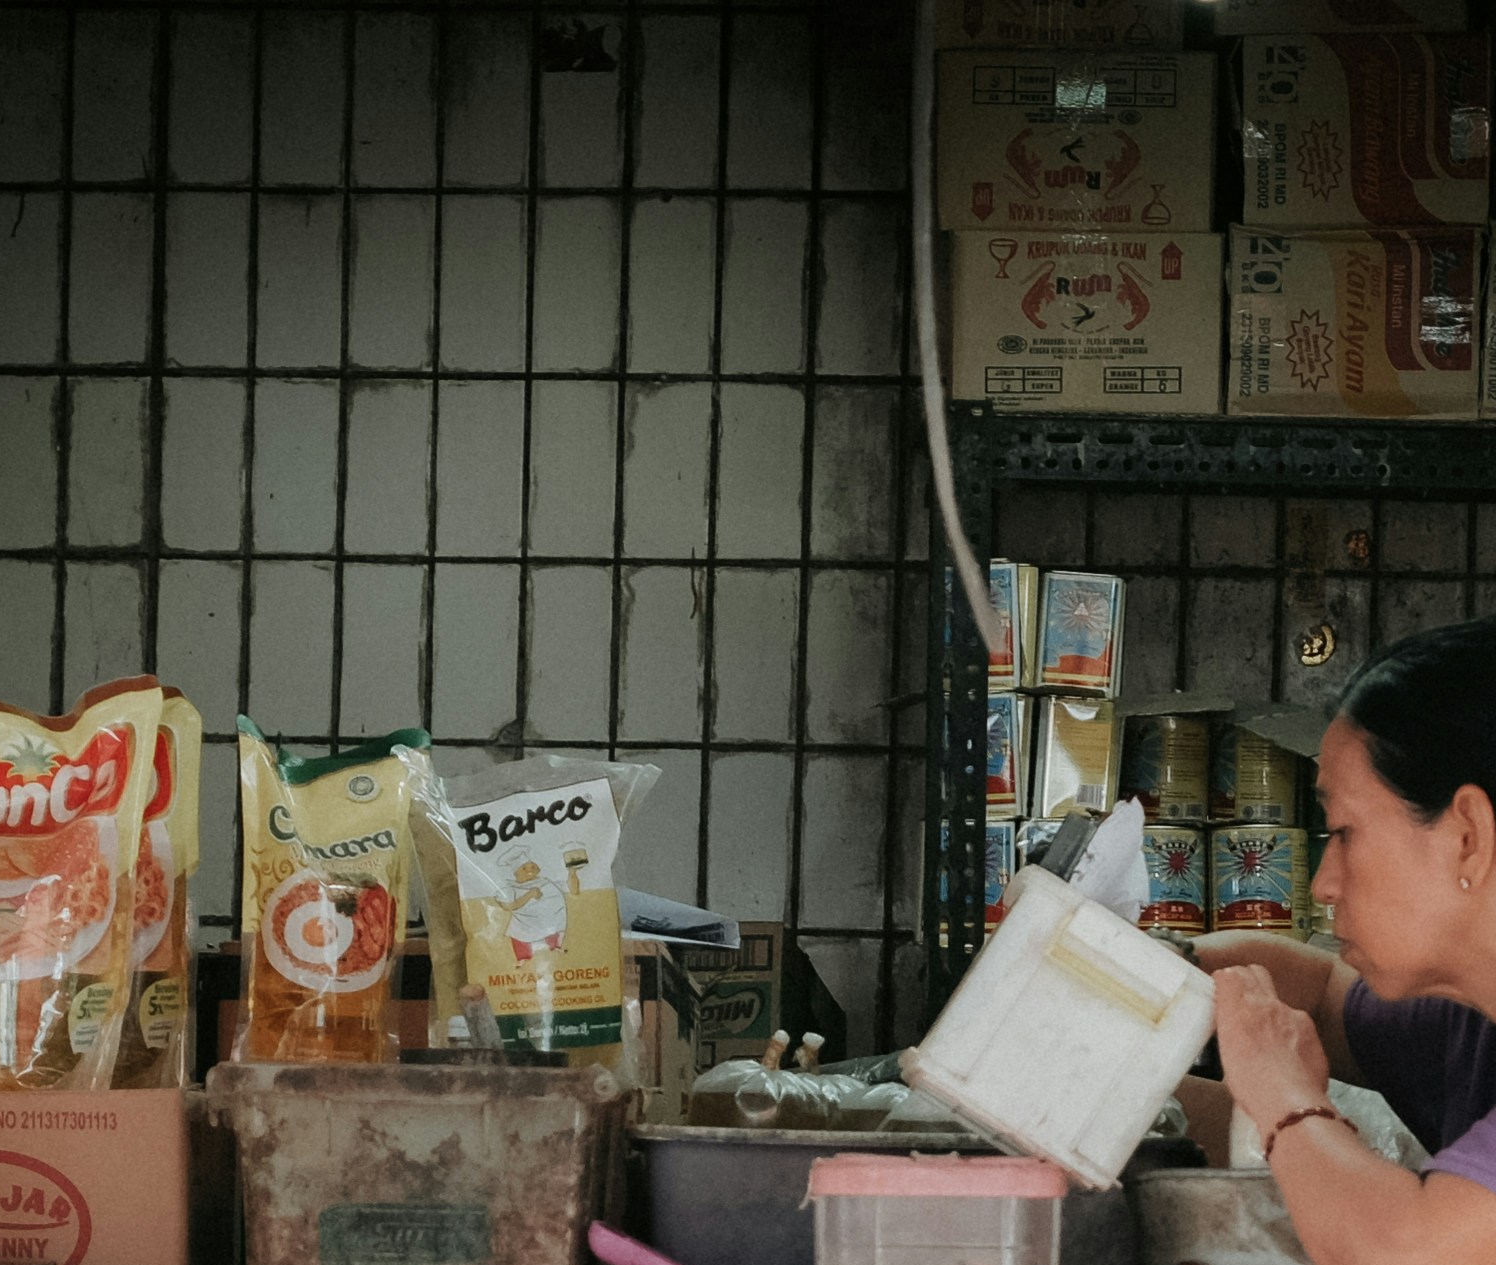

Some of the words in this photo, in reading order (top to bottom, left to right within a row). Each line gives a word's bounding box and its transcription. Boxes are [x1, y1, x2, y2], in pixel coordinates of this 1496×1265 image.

[1044, 165, 1101, 189] Rum
[1274, 183, 1286, 205] MD
[1009, 203, 1034, 222] IKAN
[1111, 243, 1118, 256] &
[1121, 243, 1147, 260] IKAN
[1165, 259, 1179, 273] UP
[1250, 237, 1283, 294] 40
[1056, 274, 1111, 296] Rum
[1347, 249, 1372, 313] Kari
[1392, 286, 1405, 328] Instan
[1258, 317, 1271, 358] BPOM
[1340, 317, 1370, 393] Ayam
[1257, 374, 1269, 394] MD
[269, 805, 397, 859] Cmara
[459, 796, 592, 852] Barco
[554, 967, 610, 982] GORENG
[20, 1111, 118, 1131] 211317301113
